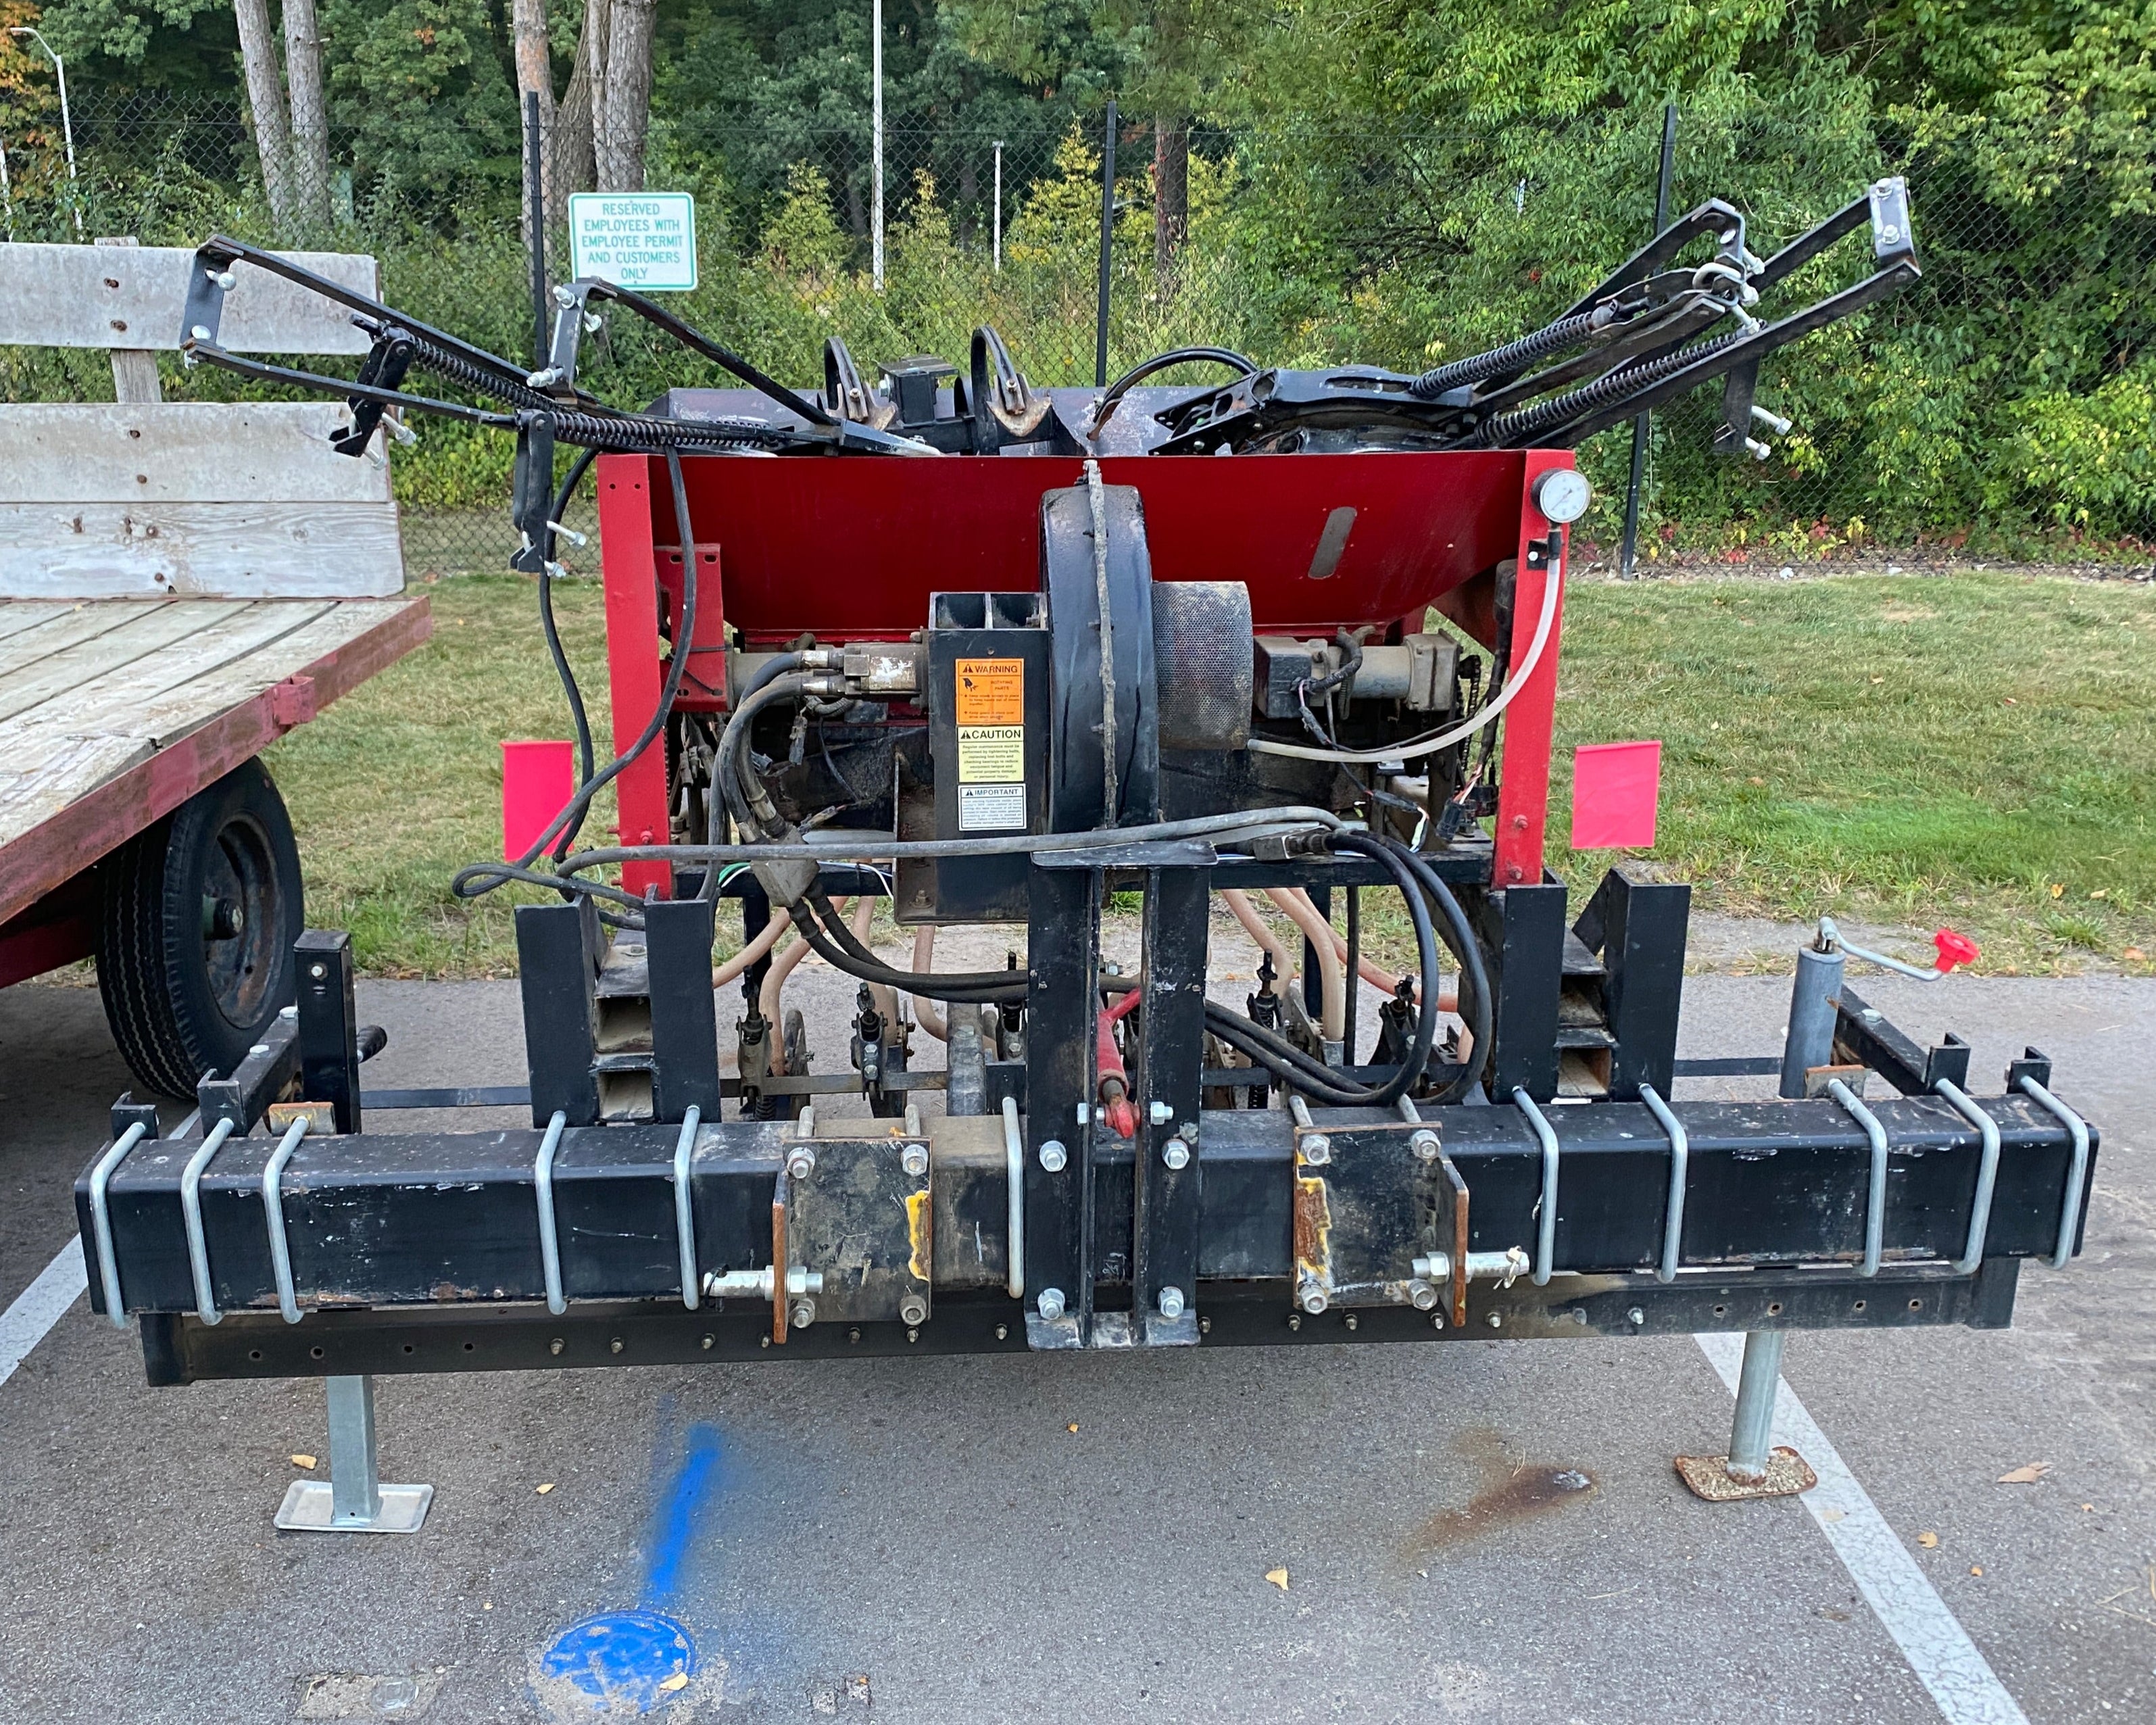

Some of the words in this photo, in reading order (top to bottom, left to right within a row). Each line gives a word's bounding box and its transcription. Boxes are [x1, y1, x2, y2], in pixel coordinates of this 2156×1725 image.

[602, 203, 660, 215] RESERVED
[584, 219, 650, 232] EMPLOYEES
[654, 219, 680, 231] WITH
[582, 236, 639, 247] EMPLOYEE
[645, 236, 683, 247] PERMIT
[588, 252, 610, 264] AND
[616, 251, 681, 264] CUSTOMERS
[621, 268, 648, 279] ONLY
[975, 665, 1018, 673] WARNING
[972, 729, 1021, 739] CAUTION
